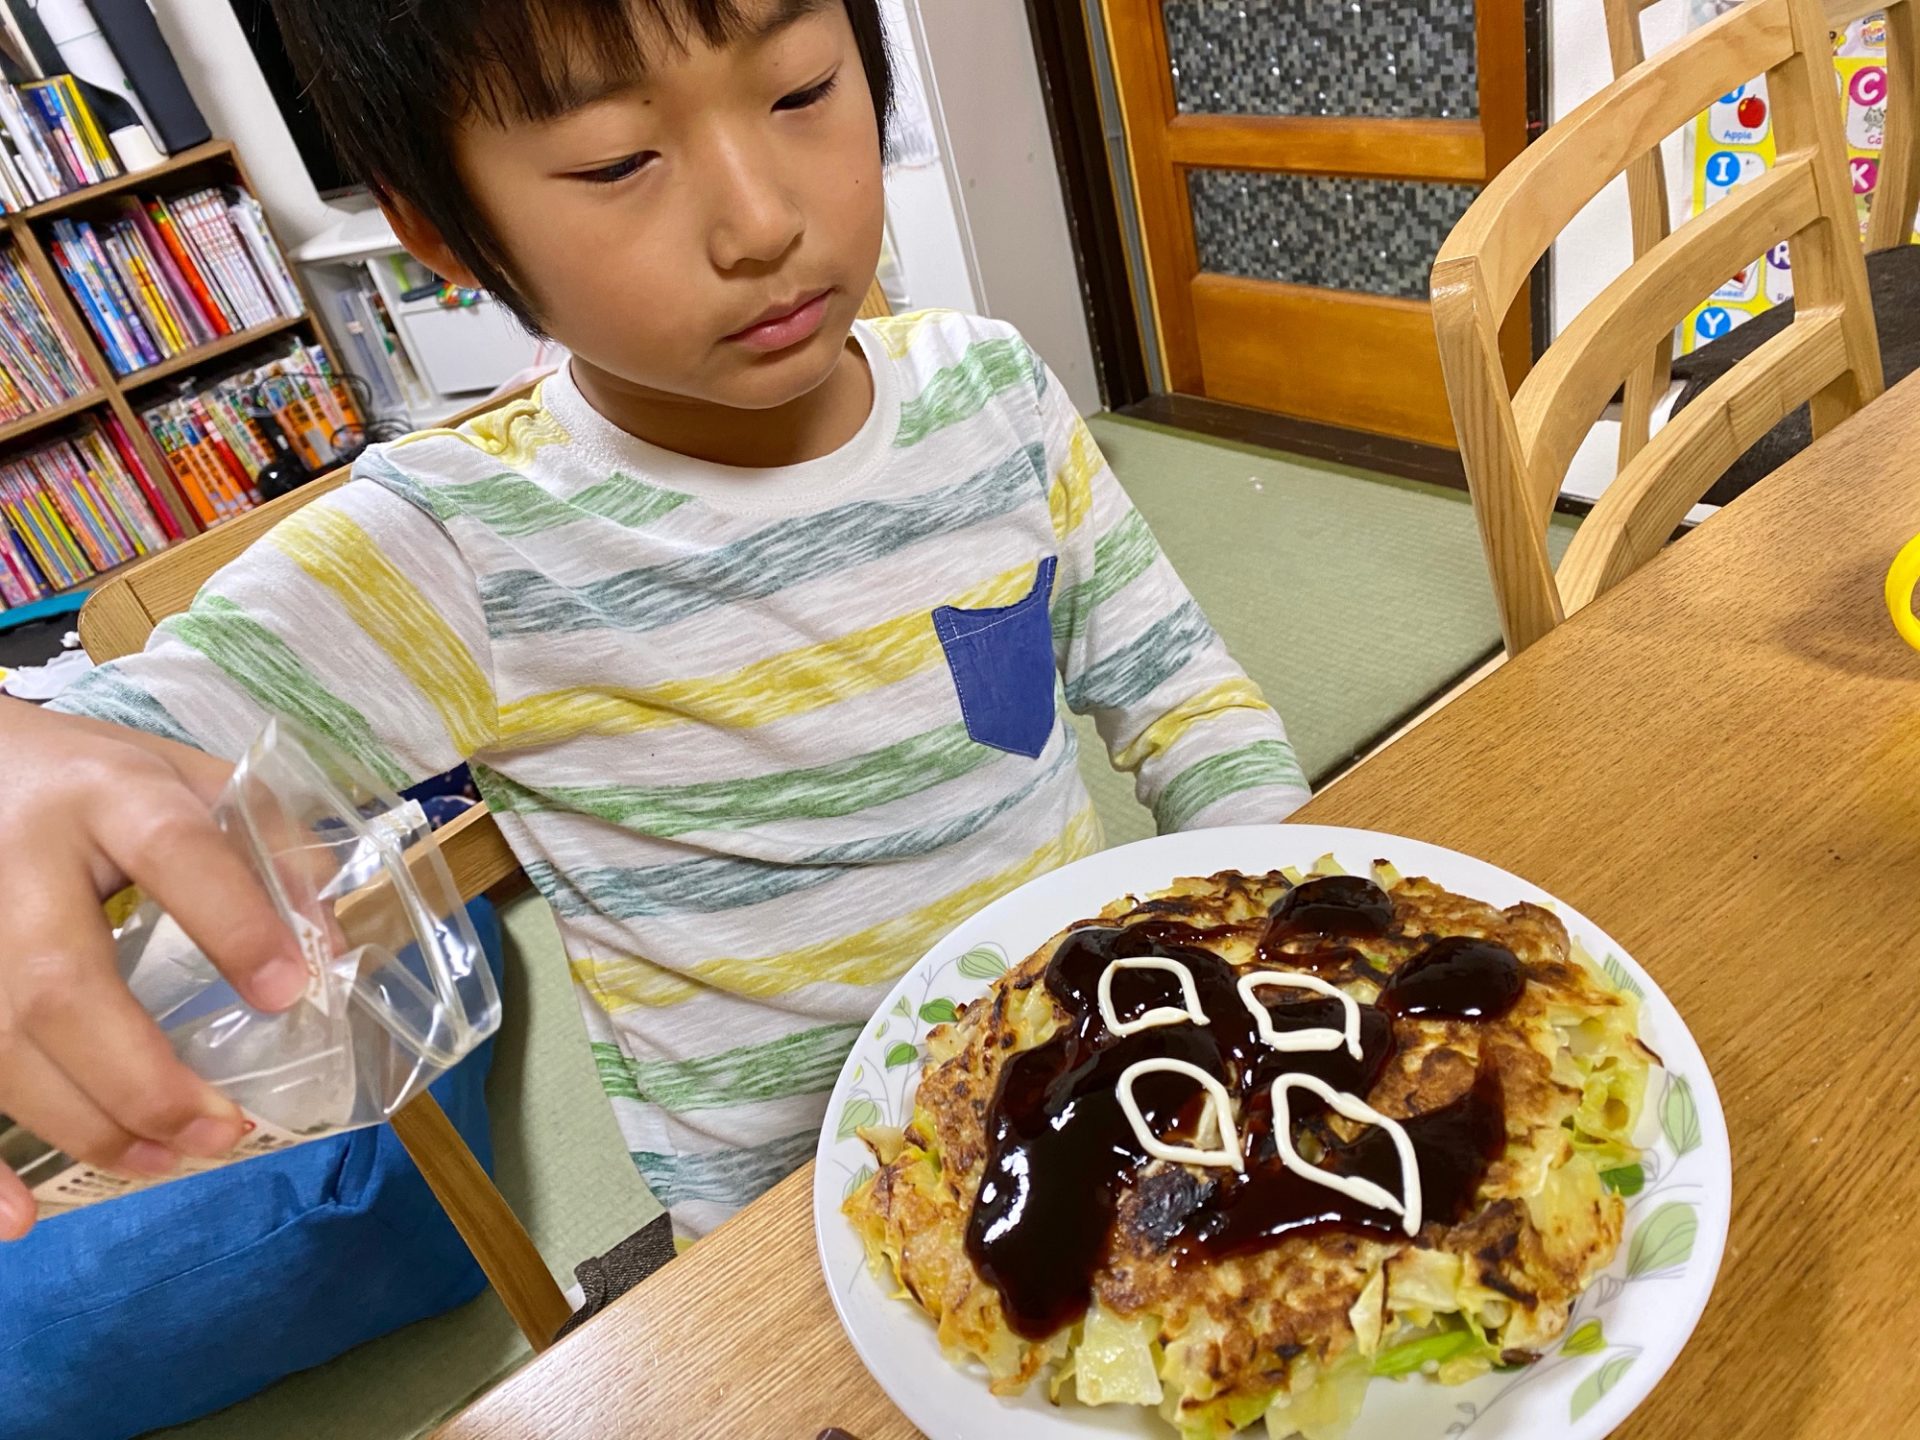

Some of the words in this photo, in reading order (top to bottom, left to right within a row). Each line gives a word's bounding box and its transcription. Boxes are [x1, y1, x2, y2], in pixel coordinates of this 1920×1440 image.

[1858, 71, 1880, 101] C
[1723, 129, 1752, 142] Apple
[1867, 134, 1882, 145] Ca
[1715, 156, 1731, 182] I
[1850, 162, 1869, 190] K
[1774, 240, 1790, 265] R
[1703, 311, 1725, 335] Y
